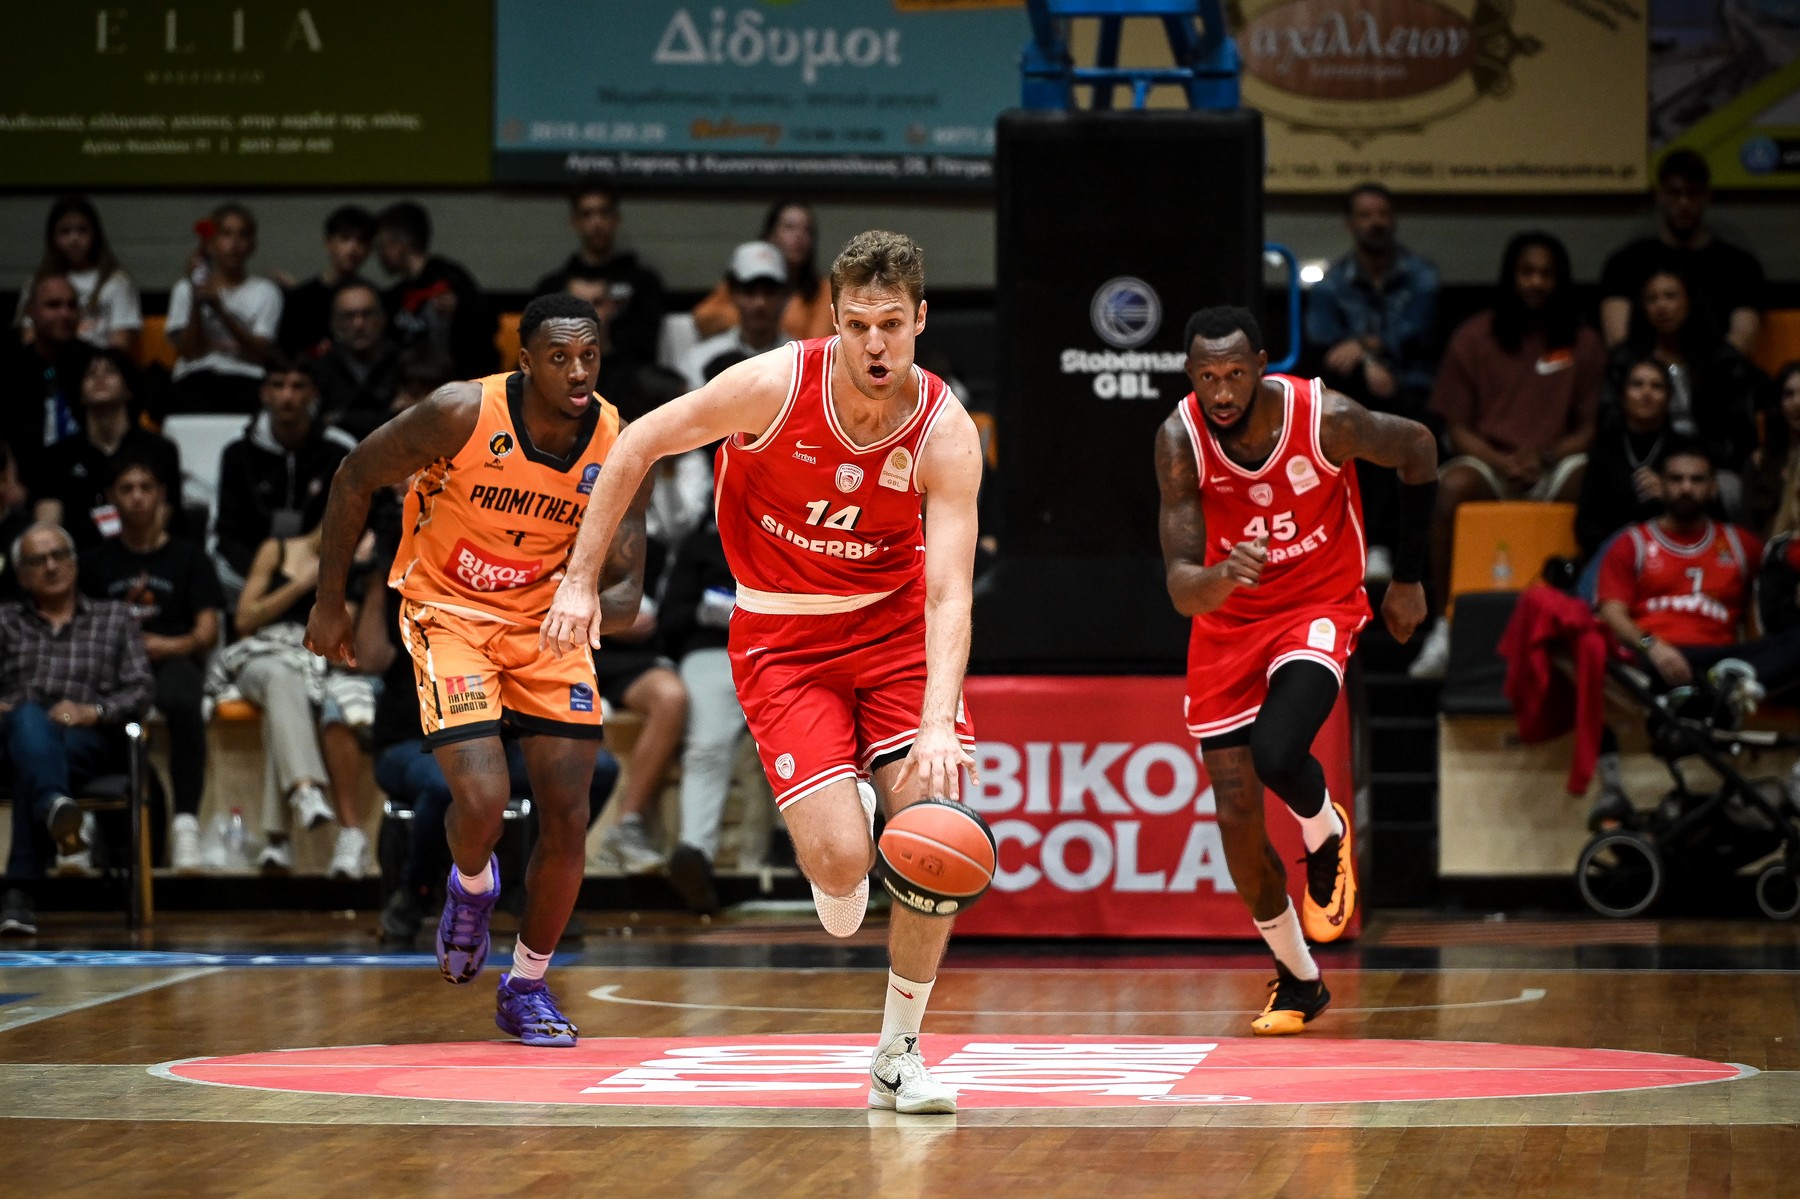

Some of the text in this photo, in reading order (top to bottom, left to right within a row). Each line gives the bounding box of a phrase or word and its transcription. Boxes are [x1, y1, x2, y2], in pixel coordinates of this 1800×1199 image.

[654, 8, 901, 83] Δίδυμοι
[1093, 373, 1160, 399] GBL
[887, 478, 901, 488] GBL
[805, 500, 863, 531] 14
[1243, 511, 1298, 541] 45
[506, 529, 526, 547] 4
[760, 514, 890, 560] SUPERBE
[989, 819, 1237, 893] COLA
